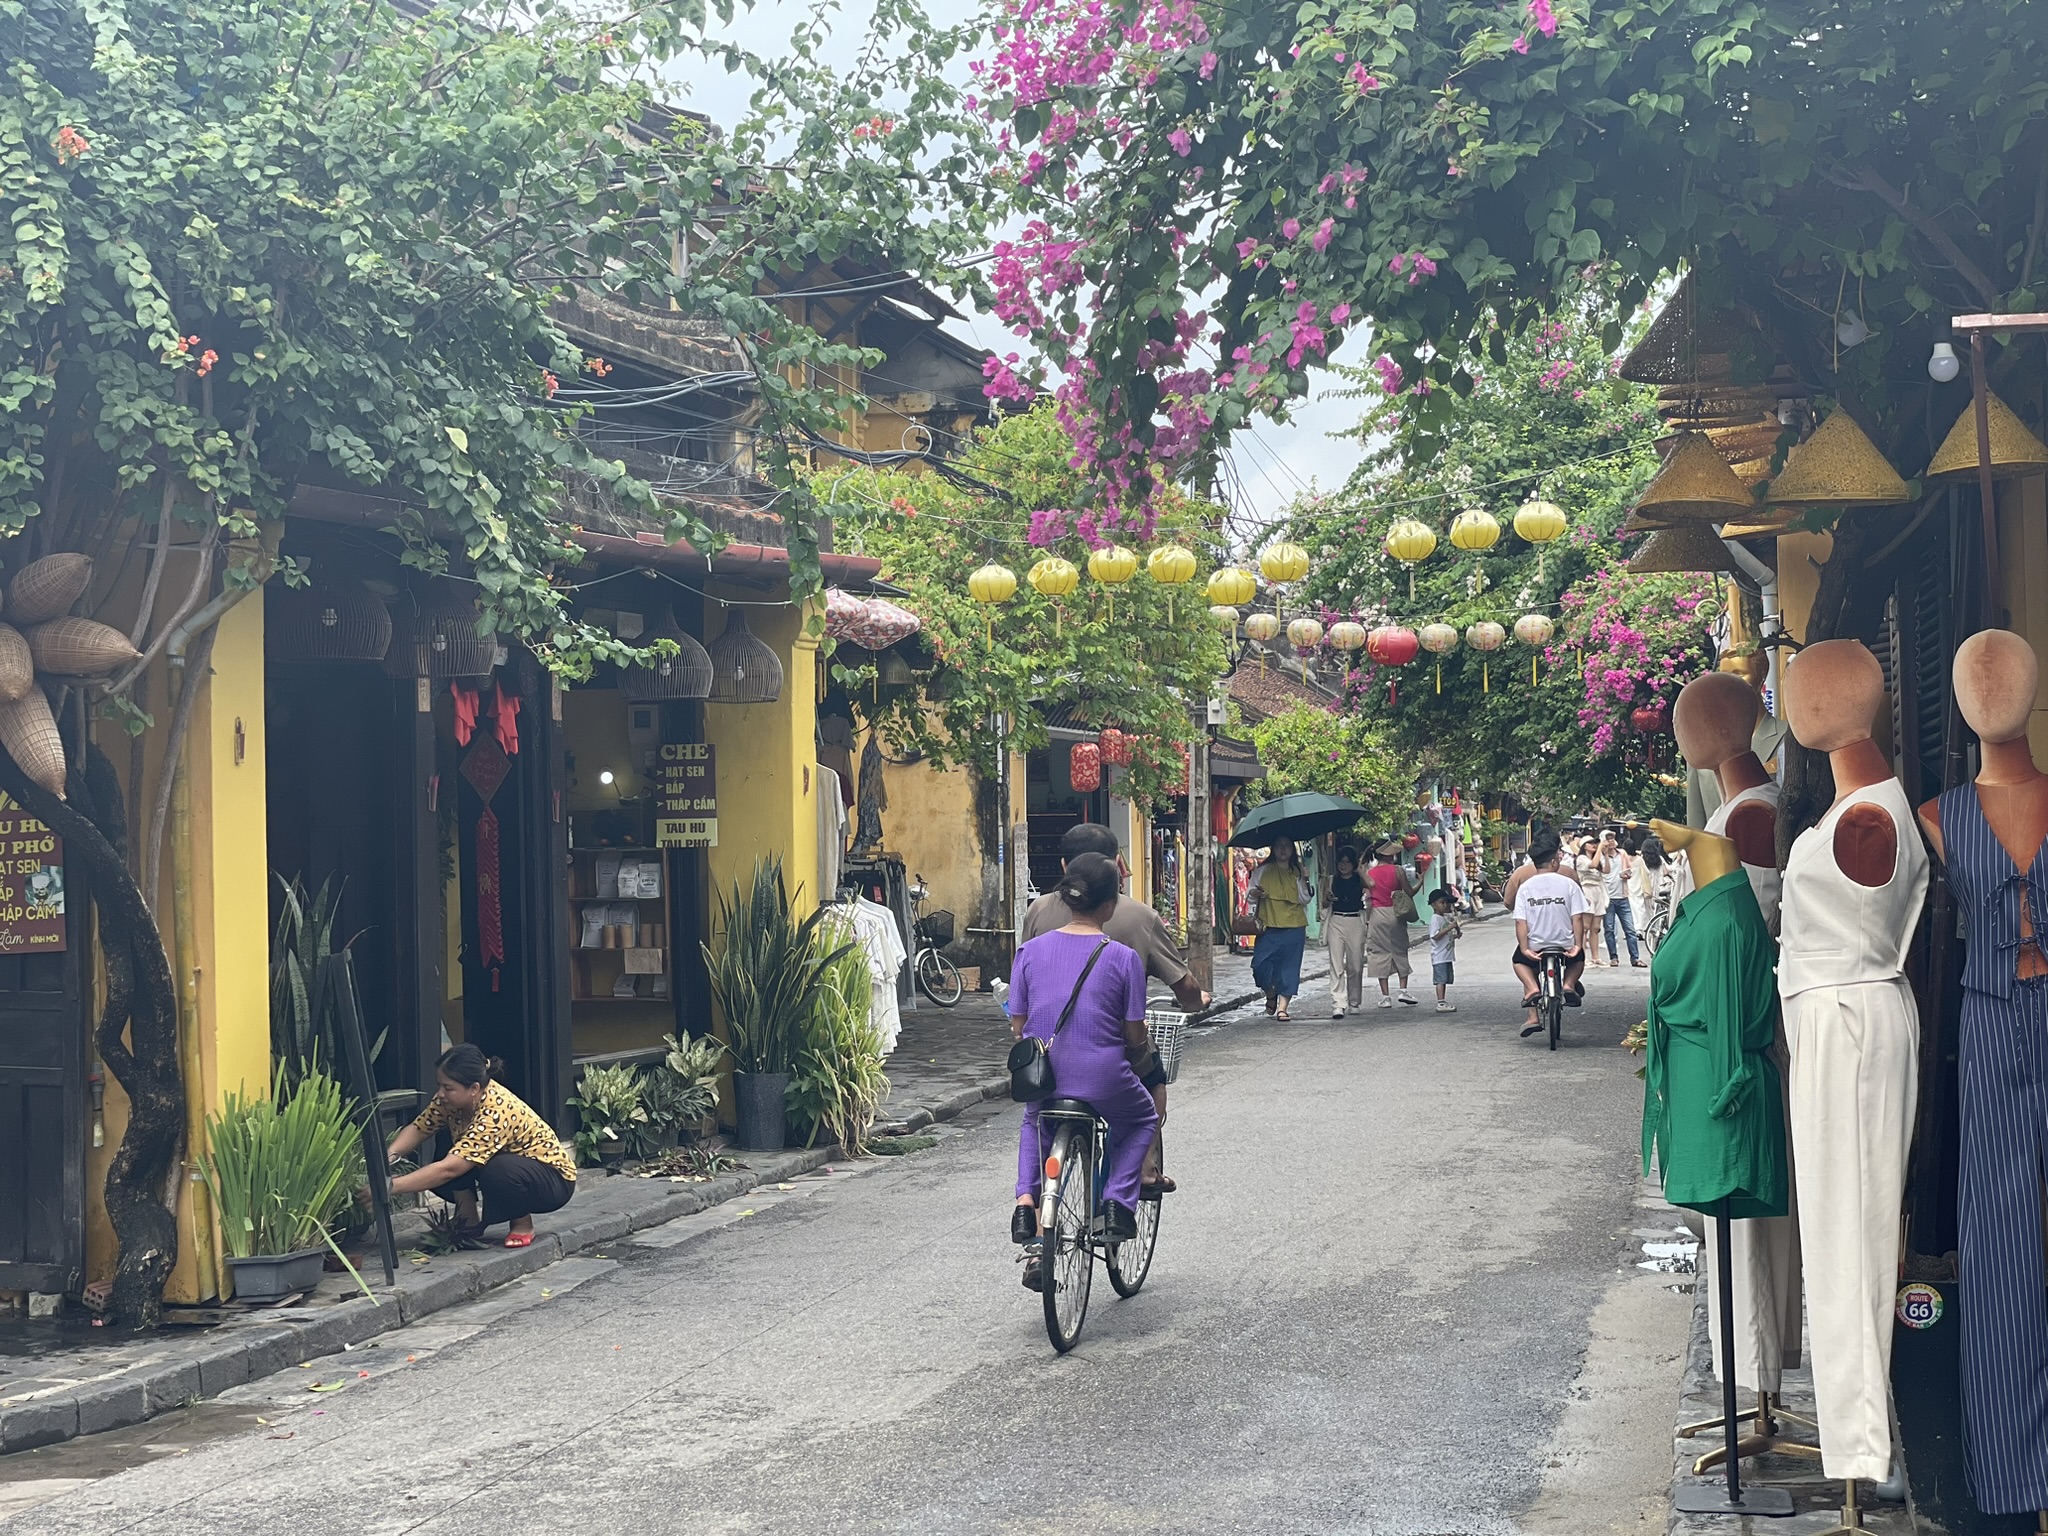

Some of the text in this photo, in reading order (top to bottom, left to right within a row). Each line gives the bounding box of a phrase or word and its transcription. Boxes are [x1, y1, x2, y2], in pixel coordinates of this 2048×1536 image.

[687, 766, 705, 777] SEN
[17, 859, 40, 874] SEN
[1909, 1303, 1929, 1318] 66
